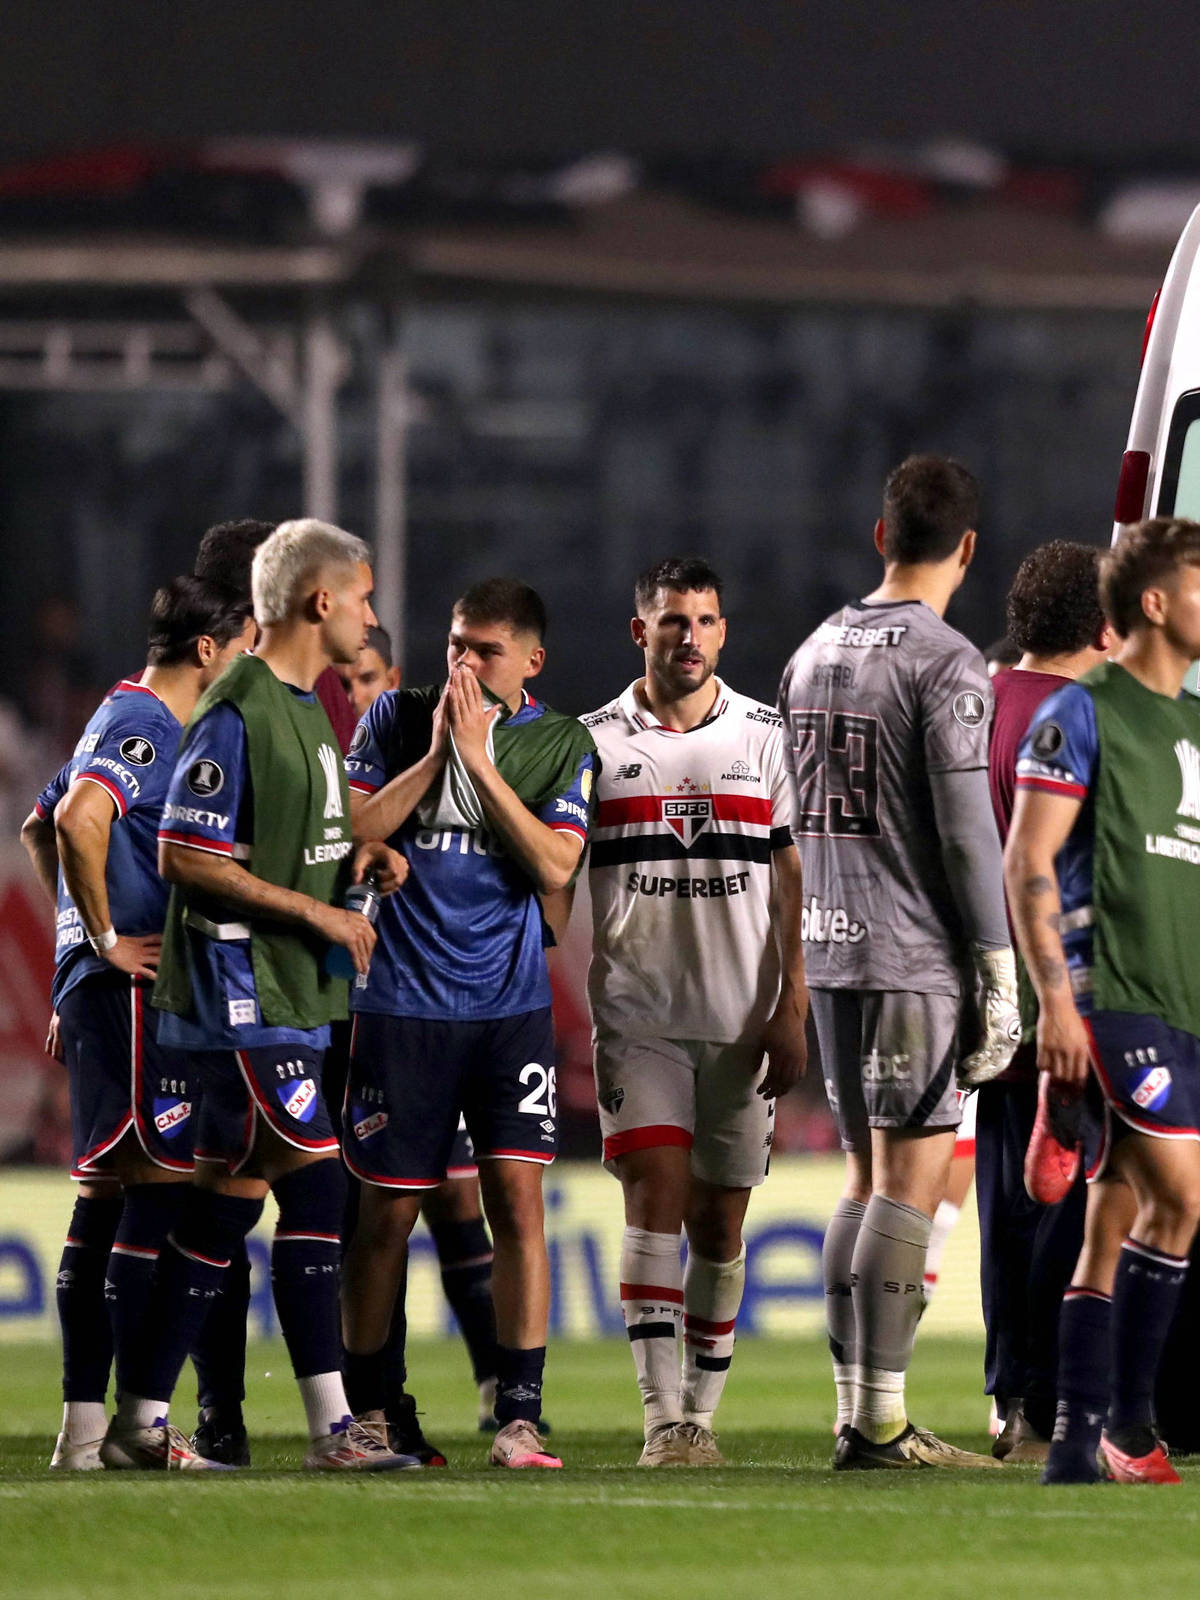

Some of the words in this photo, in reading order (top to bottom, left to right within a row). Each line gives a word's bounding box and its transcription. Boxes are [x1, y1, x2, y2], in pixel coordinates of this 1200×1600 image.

[586, 713, 620, 728] ORTE
[89, 757, 142, 799] DIRECTV
[720, 773, 761, 784] ADEMICON
[162, 803, 230, 830] DIRECTV
[666, 802, 709, 815] SPFC
[627, 871, 750, 898] SUPERBET
